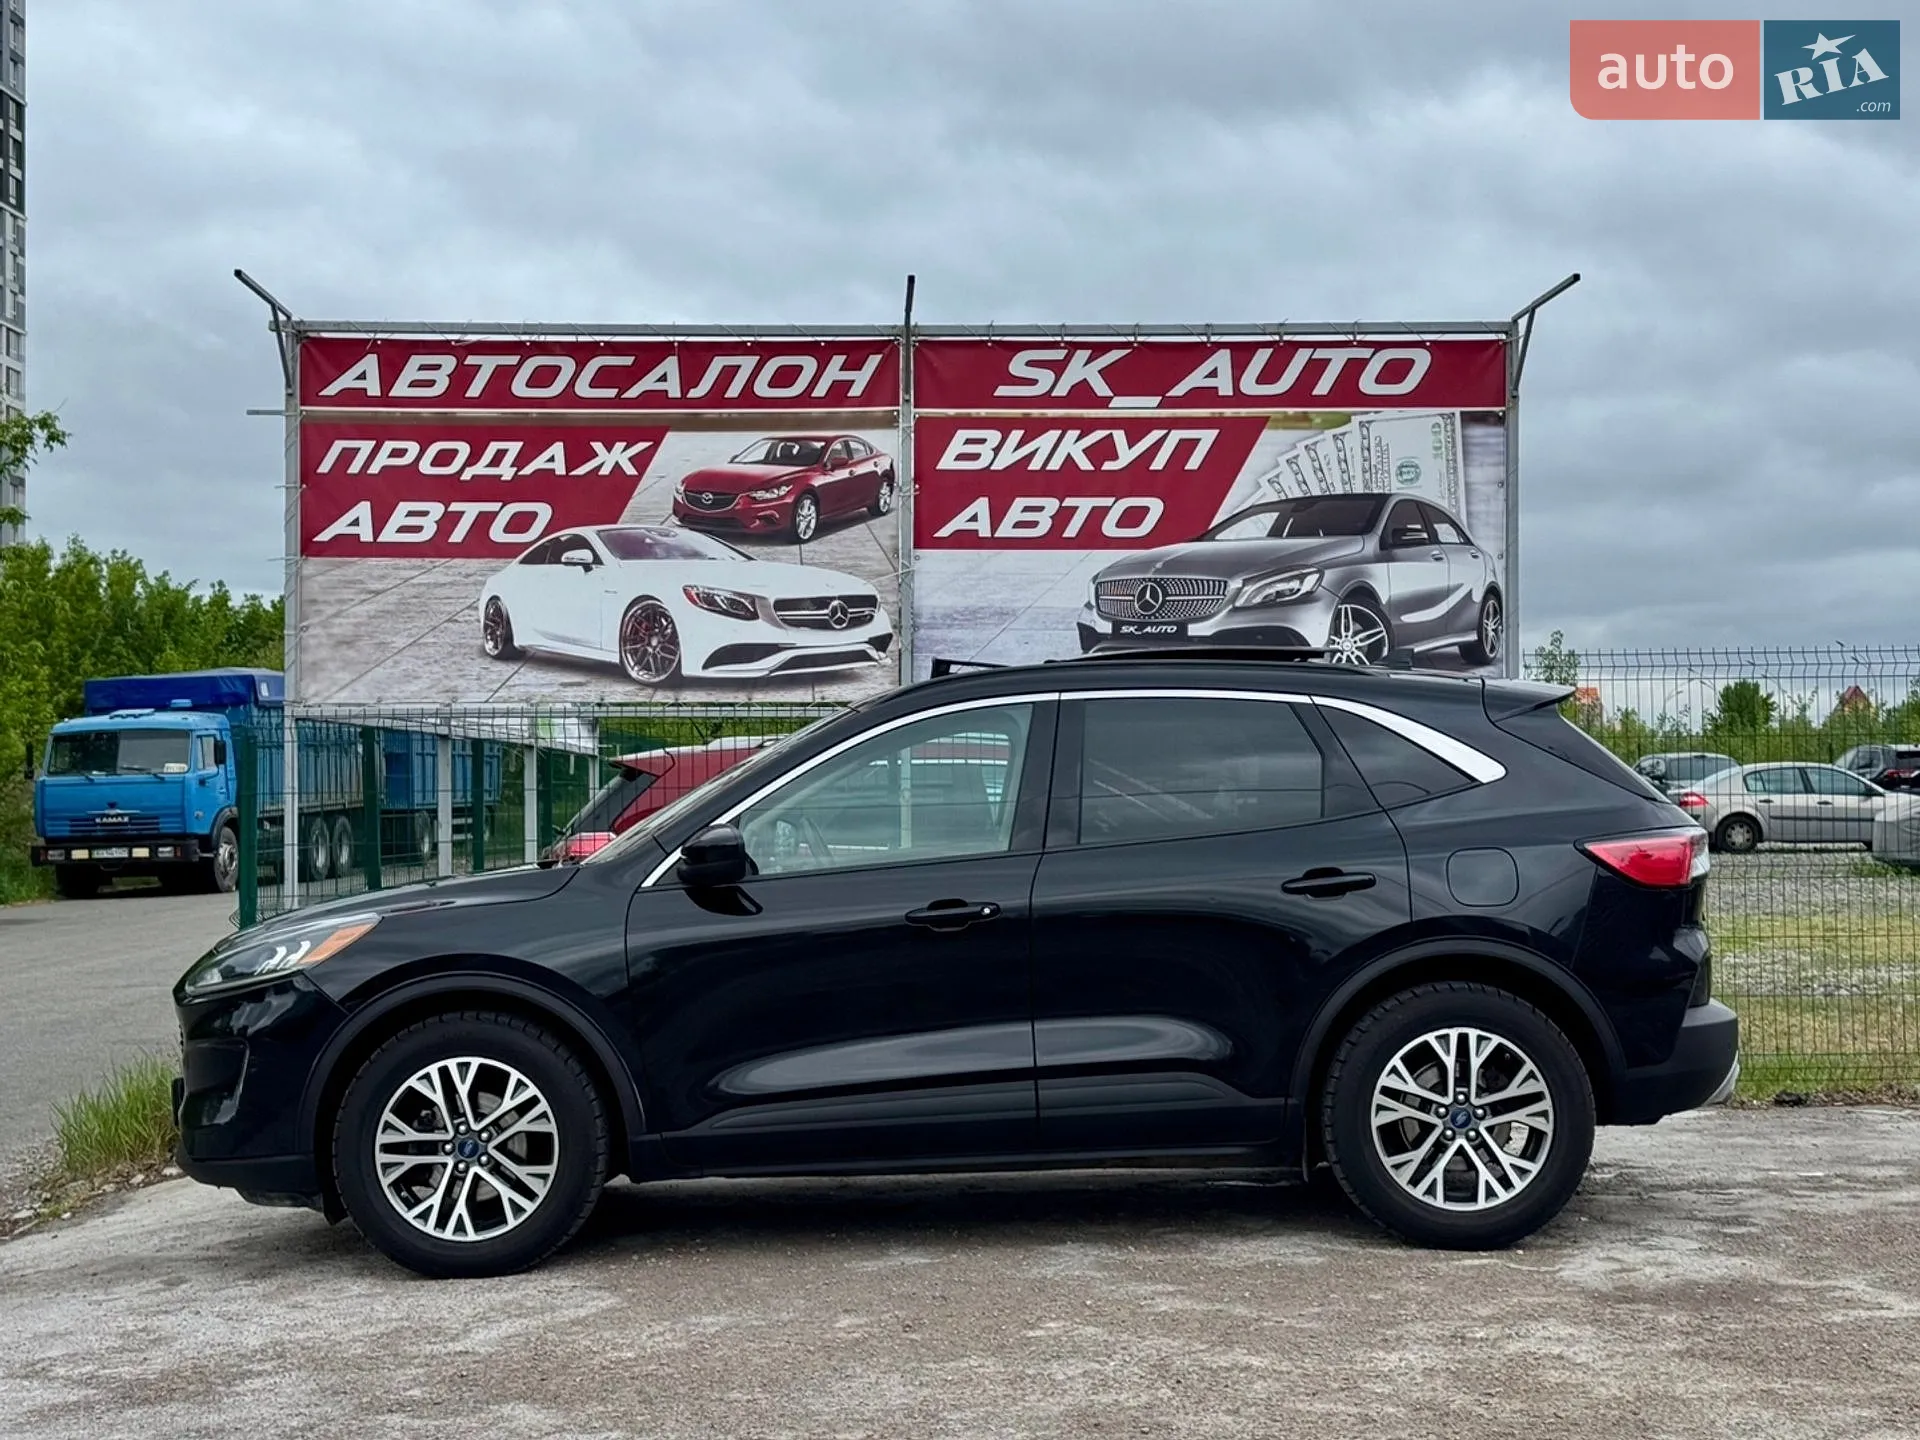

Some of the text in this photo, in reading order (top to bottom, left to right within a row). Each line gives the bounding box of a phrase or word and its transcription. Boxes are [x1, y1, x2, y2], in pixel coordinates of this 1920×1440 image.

[319, 353, 883, 399] АВТОСАЛОН
[993, 347, 1432, 408] SK_AUTO
[316, 439, 655, 481] ПРОДАЖ
[935, 428, 1221, 472] ВИКУП
[312, 500, 553, 544] АВТО
[932, 496, 1165, 539] АВТО
[1119, 625, 1178, 635] SK_AUTO
